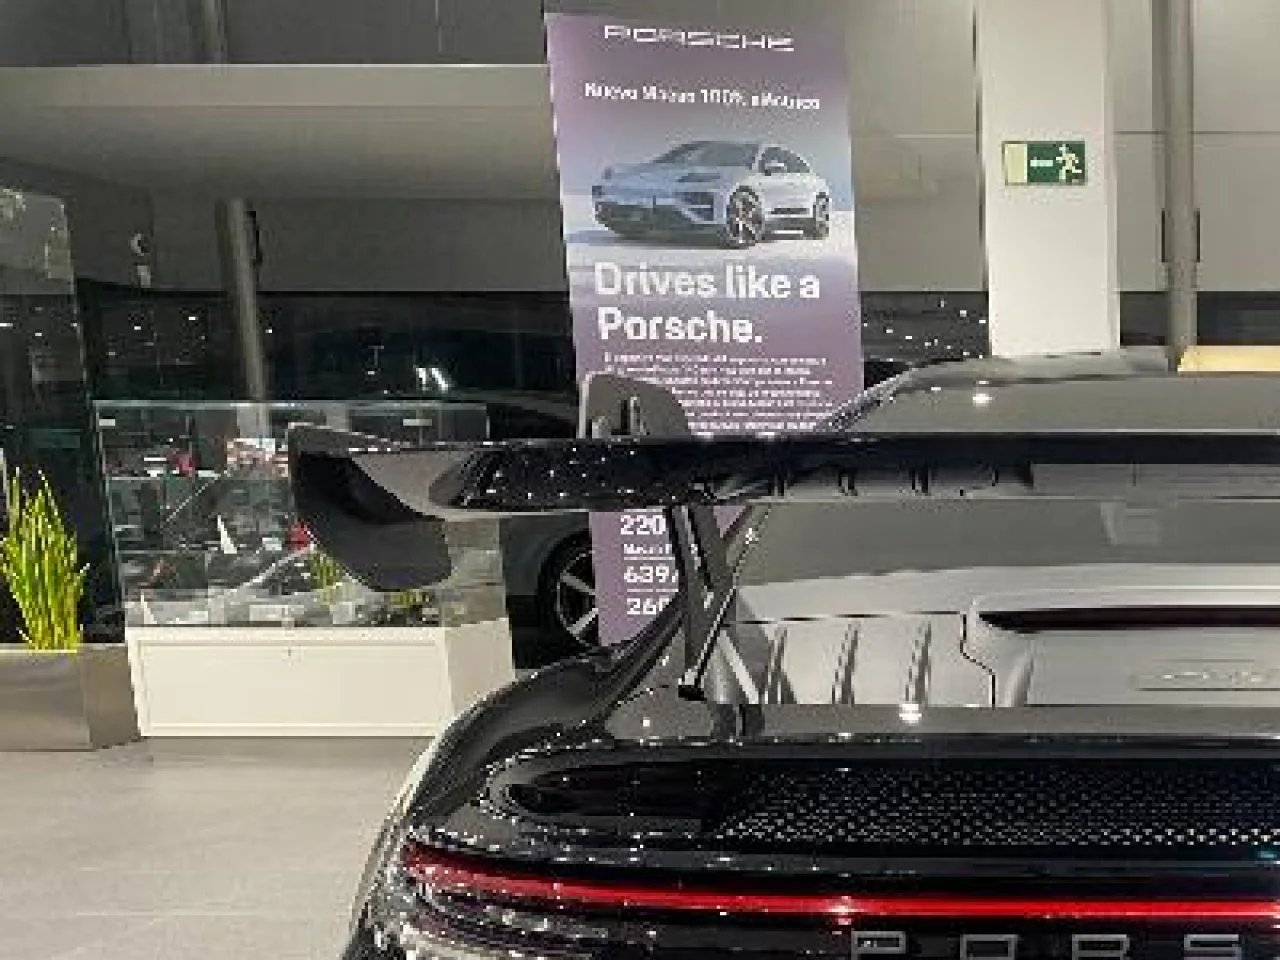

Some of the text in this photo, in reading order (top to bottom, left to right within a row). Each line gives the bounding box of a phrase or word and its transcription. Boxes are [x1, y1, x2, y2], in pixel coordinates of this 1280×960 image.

[604, 25, 794, 51] PORSCHE
[594, 262, 820, 299] Drives like a
[598, 306, 763, 343] Porsche.
[620, 515, 667, 535] 220
